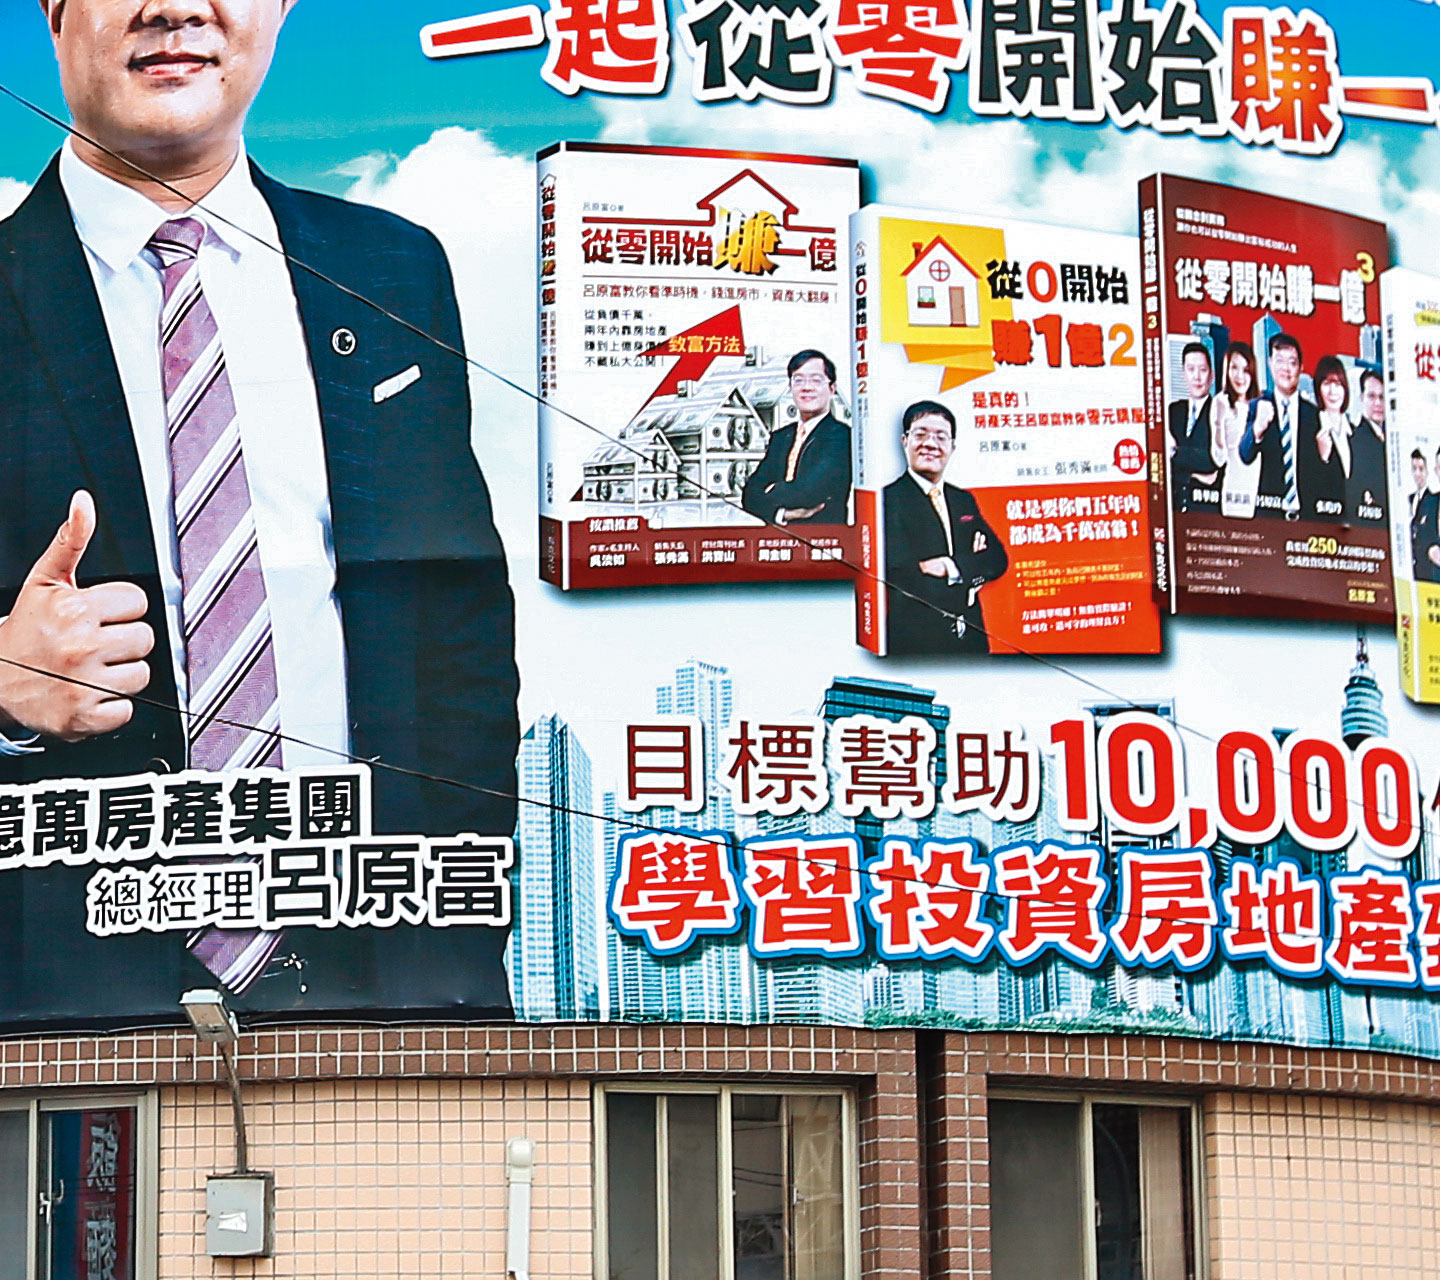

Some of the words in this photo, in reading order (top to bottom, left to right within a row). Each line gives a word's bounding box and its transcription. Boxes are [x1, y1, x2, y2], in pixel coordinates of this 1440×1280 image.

[582, 206, 838, 276] 從零開始賺一億
[1356, 252, 1375, 283] 3
[986, 259, 1130, 305] 從0開始
[1174, 257, 1367, 325] 從零開始賺一億
[669, 336, 741, 354] 致富方法
[992, 314, 1138, 367] 賺1億2
[93, 838, 508, 931] 總經理呂原富
